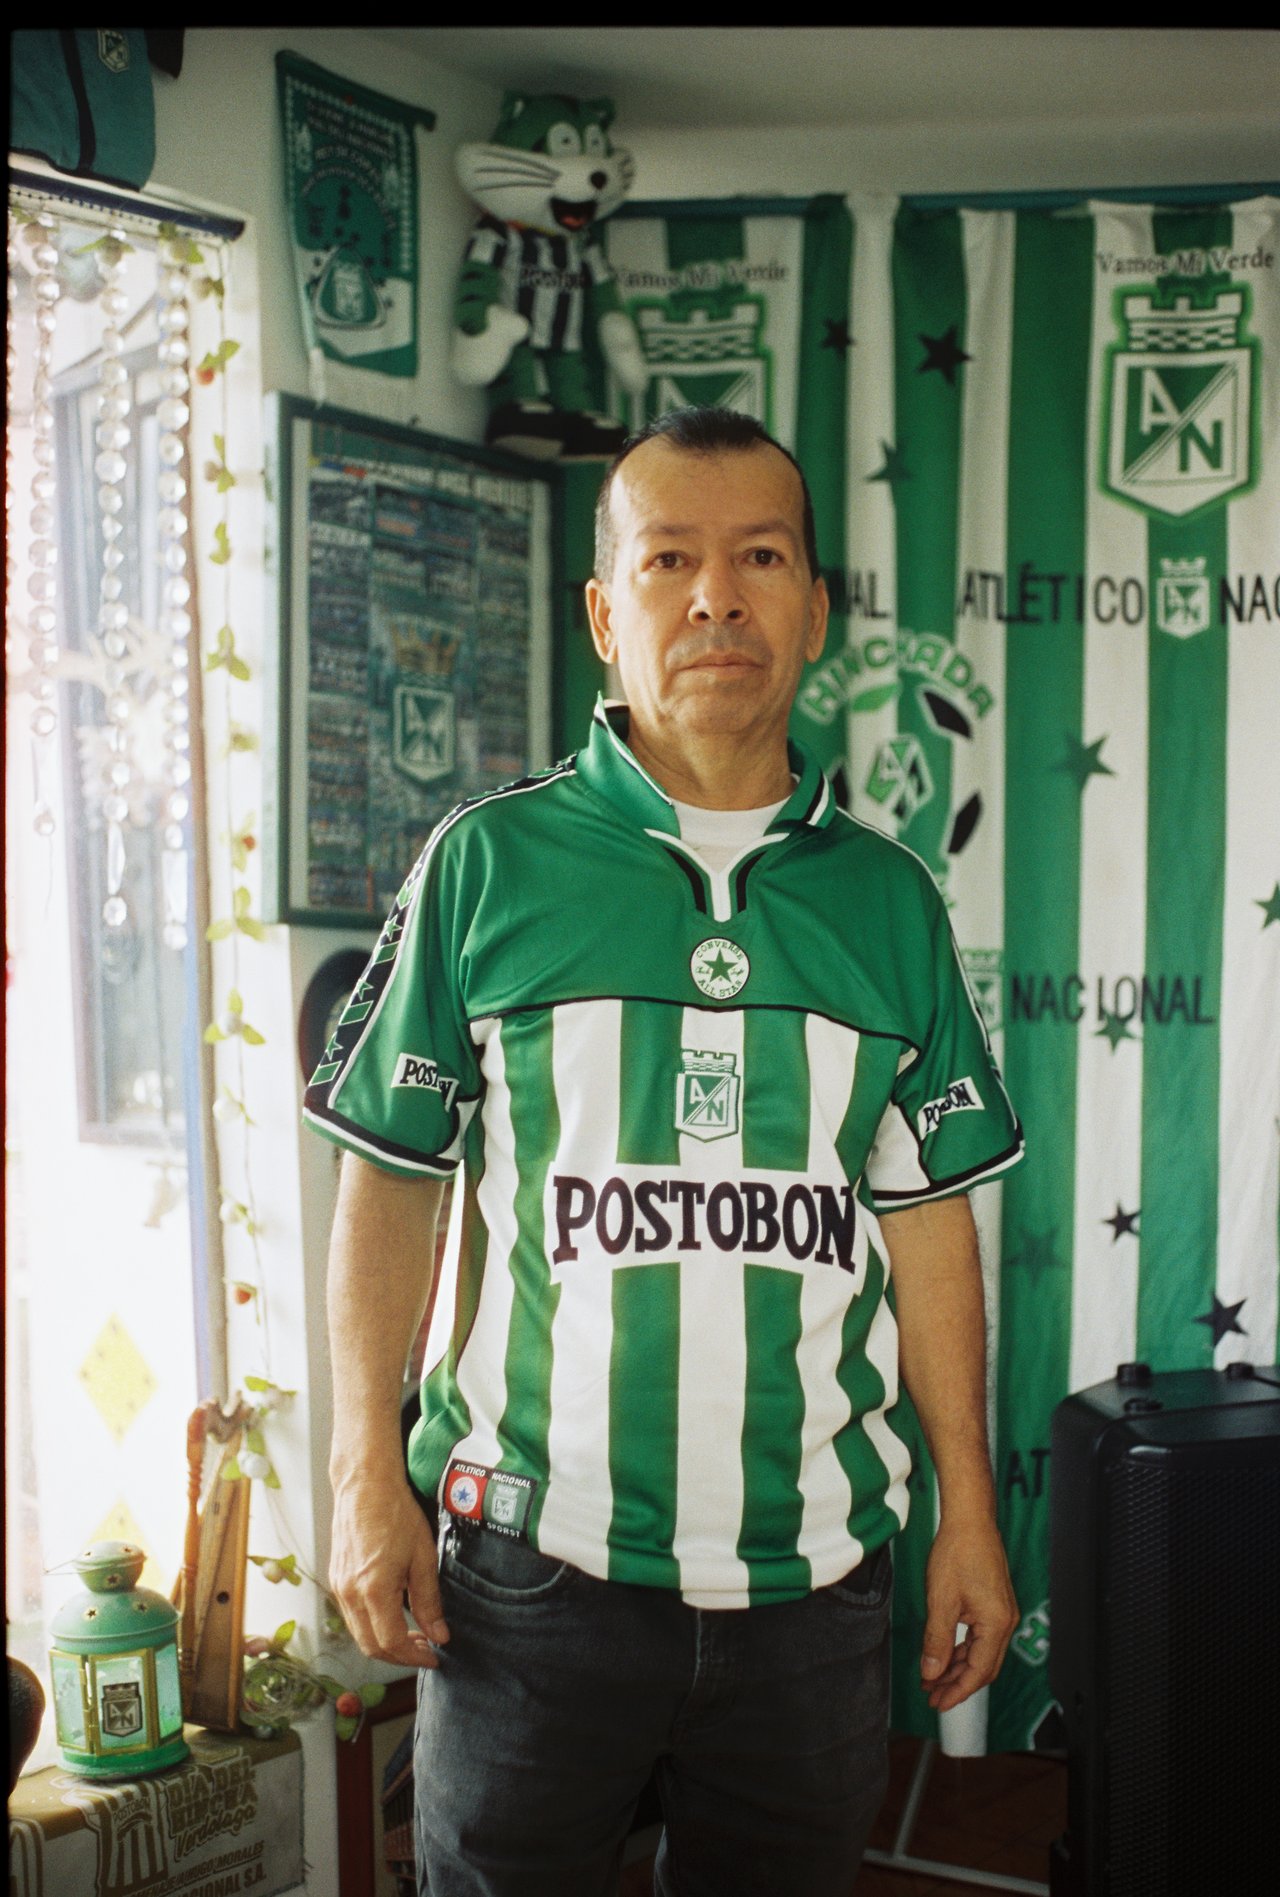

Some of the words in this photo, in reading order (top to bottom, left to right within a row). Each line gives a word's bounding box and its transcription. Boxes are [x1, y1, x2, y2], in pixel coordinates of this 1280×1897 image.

[1097, 252, 1169, 275] Vamos
[1176, 251, 1203, 275] Mi
[1209, 245, 1275, 270] Verde
[957, 563, 1145, 625] ATLÉTICO
[696, 940, 744, 961] CONVERSE
[698, 979, 716, 997] ALL
[719, 979, 743, 998] STAR
[1010, 973, 1217, 1025] NACIONAL
[553, 1175, 857, 1275] POSTOBON
[454, 1463, 487, 1477] ATLETICO
[491, 1472, 532, 1488] NACIONAL
